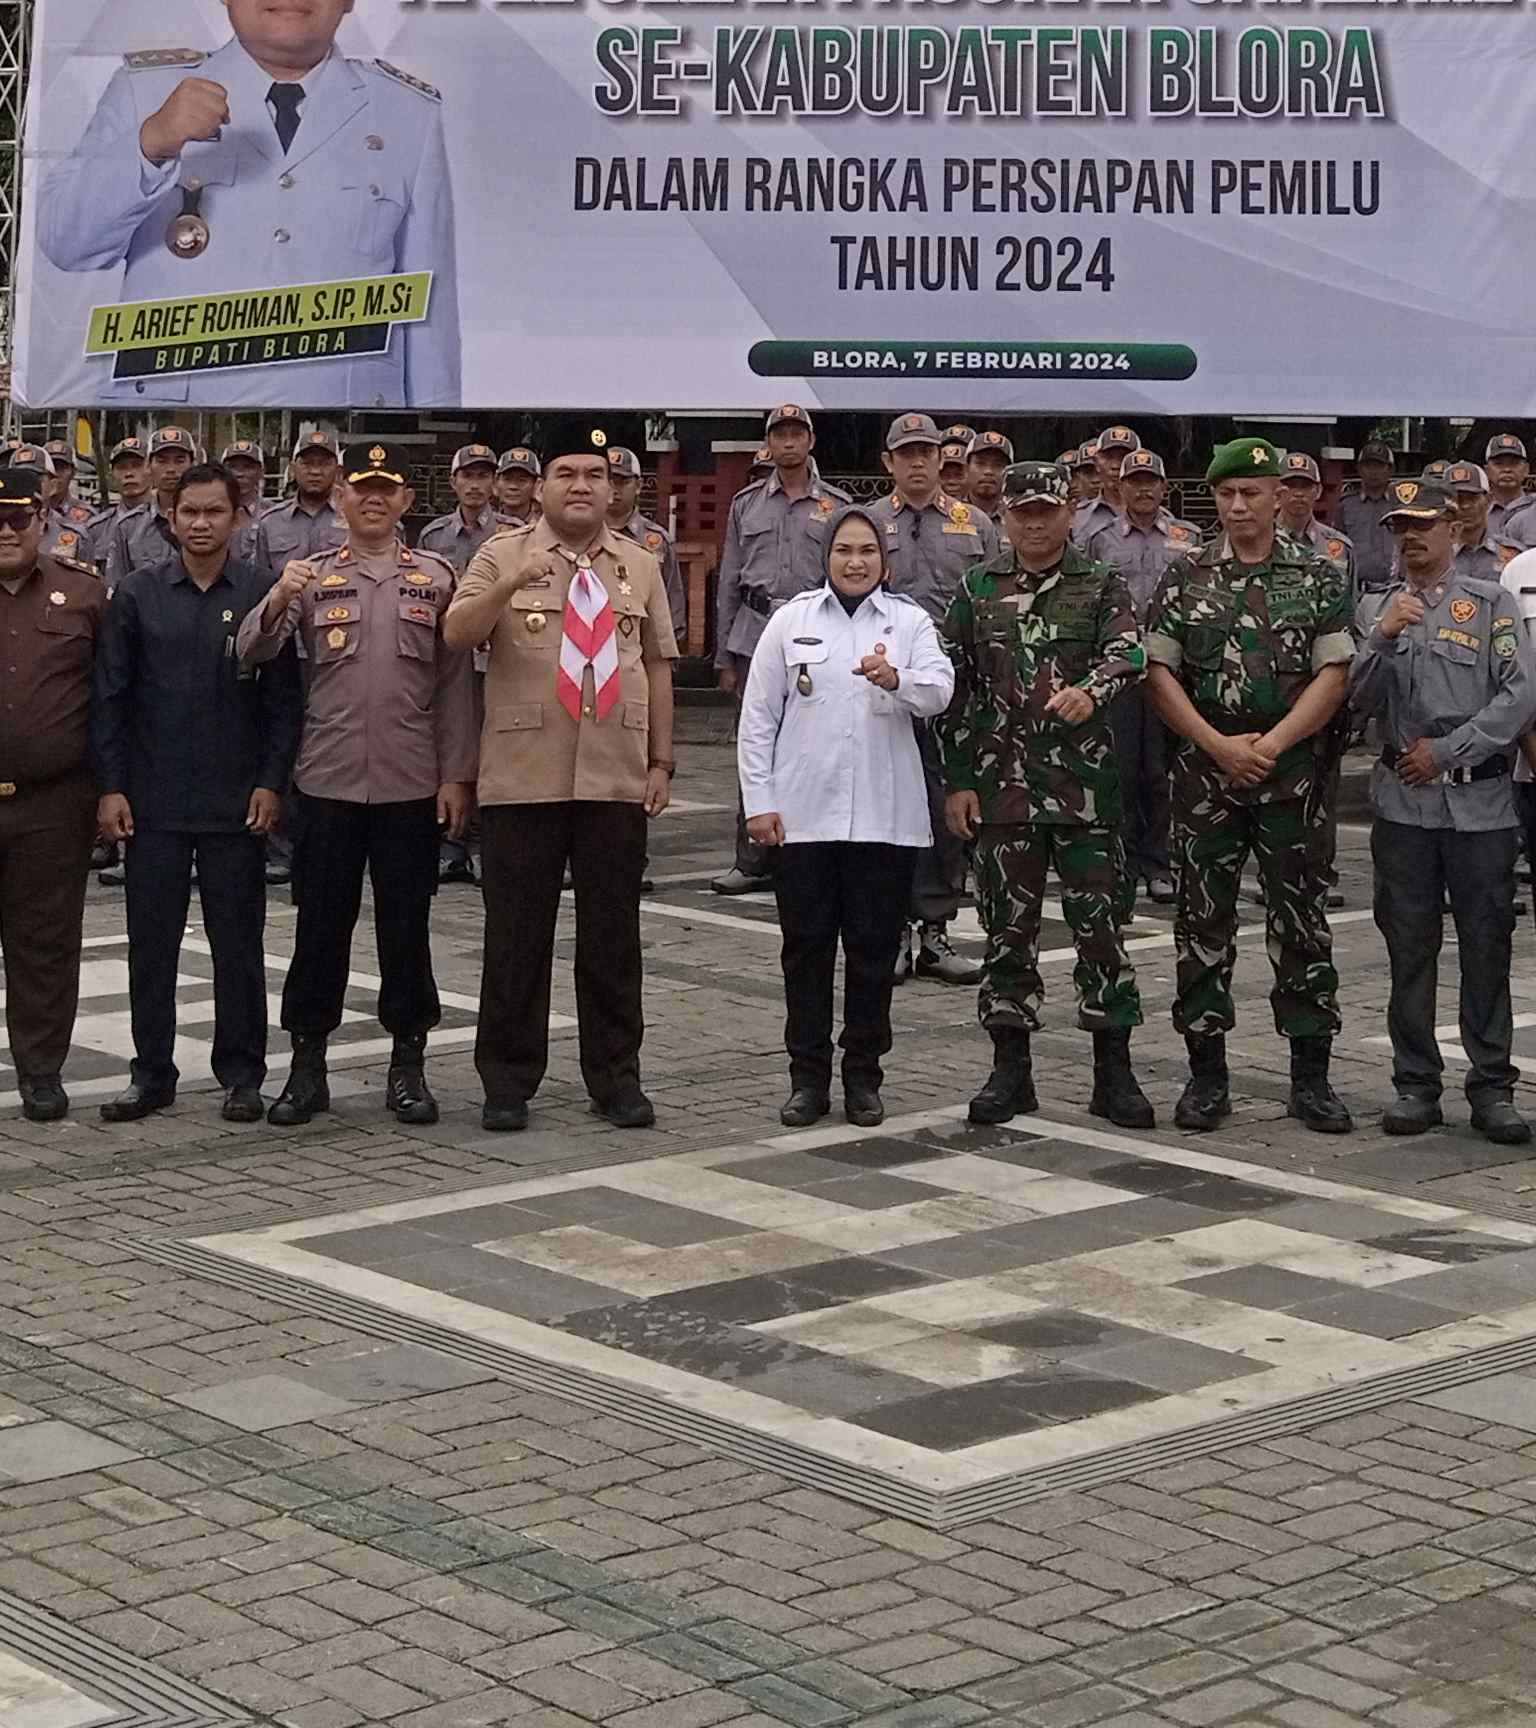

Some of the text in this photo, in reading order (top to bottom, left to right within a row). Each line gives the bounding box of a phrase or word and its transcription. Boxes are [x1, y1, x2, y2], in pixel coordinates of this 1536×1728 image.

[594, 26, 1385, 117] SE-KABUPATEN BLORA
[574, 157, 1381, 216] DALAM RANGKA PERSIAPAN PEMILU
[830, 236, 1116, 292] TAHUN 2024
[102, 282, 412, 344] H. ARIEF ROHMAN, S.IP, M.Si
[155, 331, 347, 370] BUPATI BLORA
[812, 351, 1131, 371] BLORA, 7 FEBRUARI 2024
[398, 587, 437, 602] POLRI
[1271, 588, 1314, 603] TNI-AD
